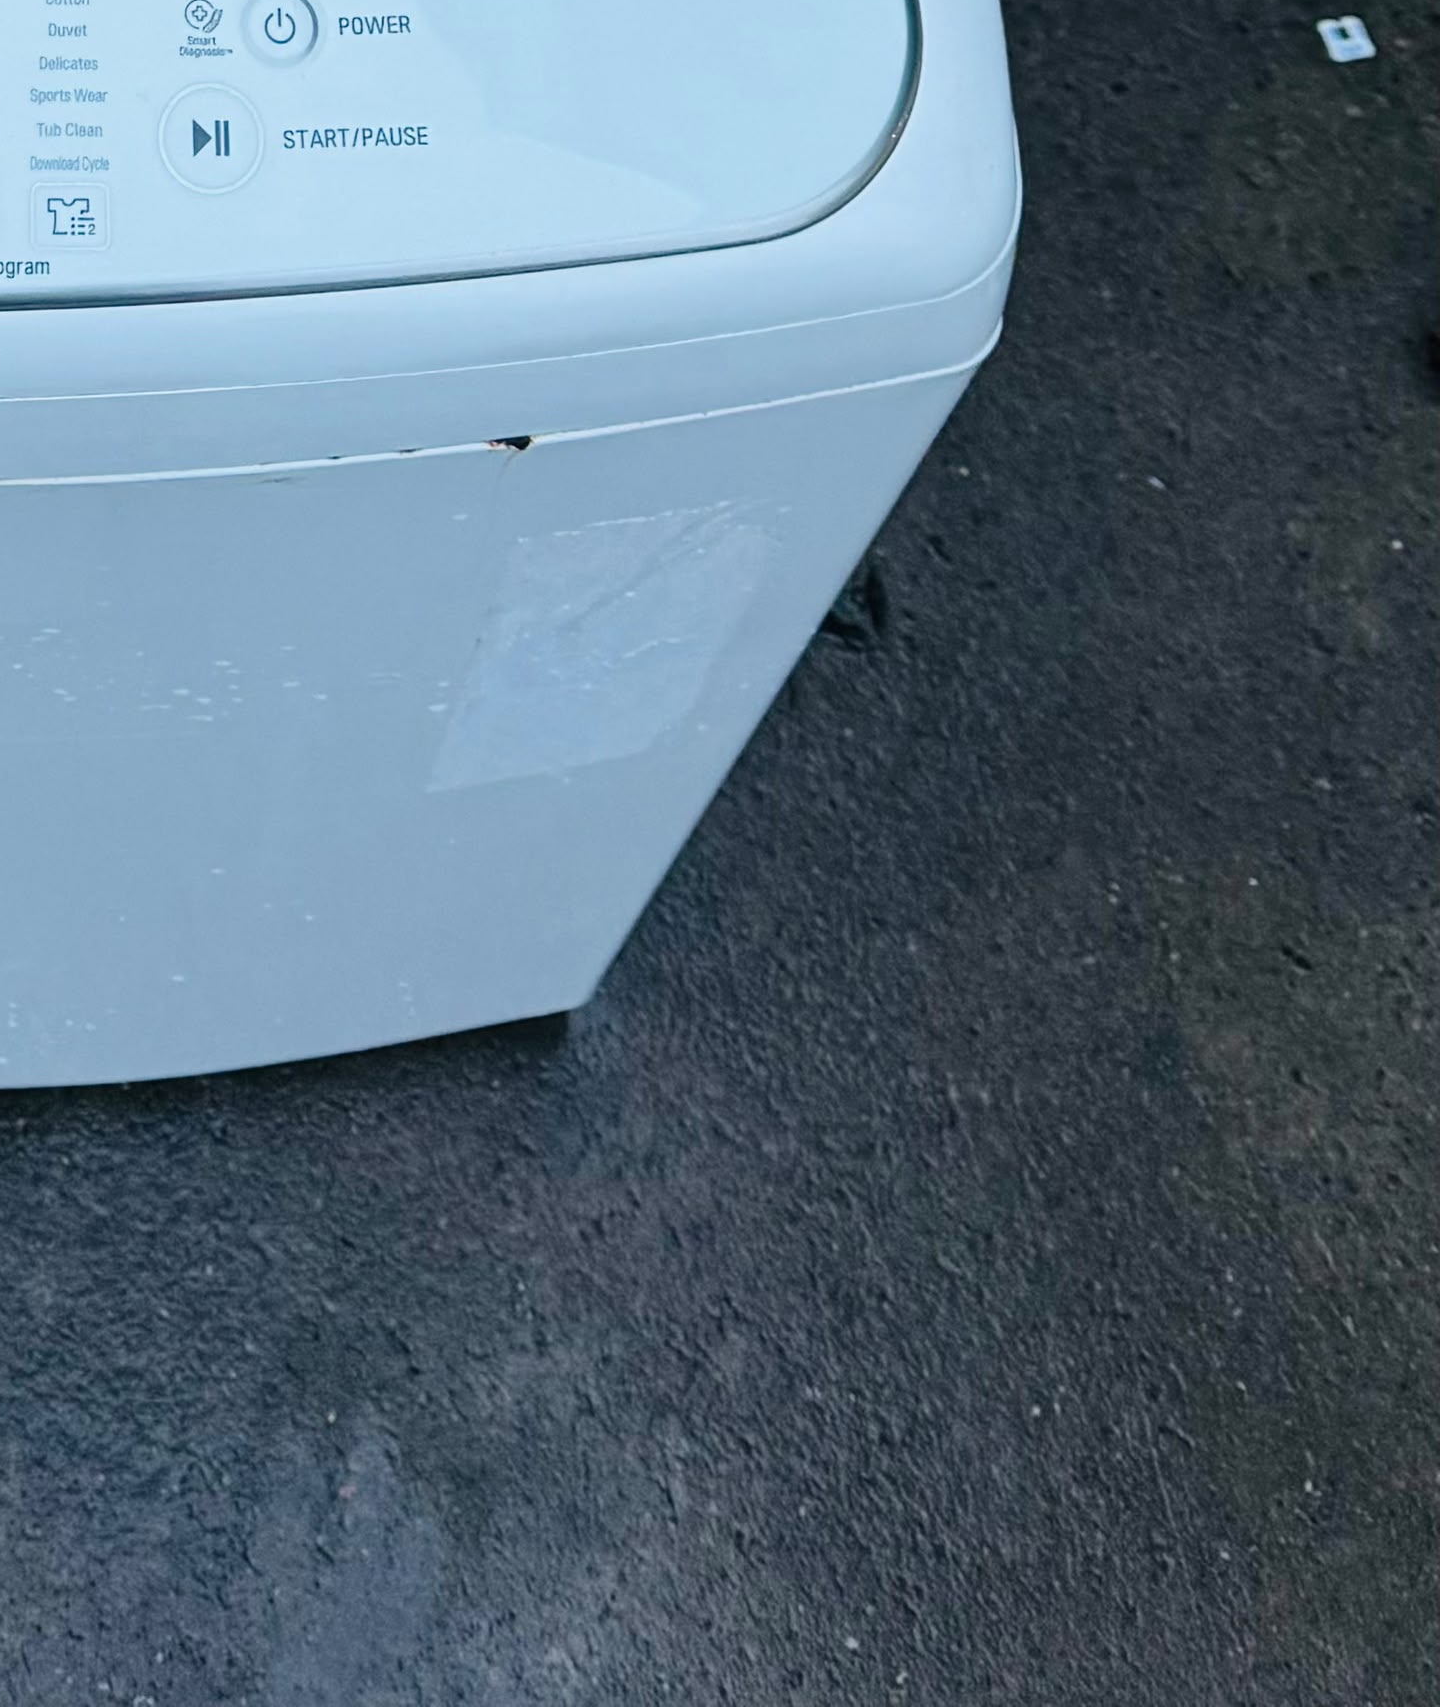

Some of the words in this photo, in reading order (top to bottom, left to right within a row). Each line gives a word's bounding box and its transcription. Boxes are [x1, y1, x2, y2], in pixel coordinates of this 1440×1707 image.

[48, 23, 87, 37] Duvet
[338, 15, 411, 36] POWER
[187, 35, 217, 46] Smart
[39, 56, 98, 71] Delicates
[30, 88, 71, 105] Sports
[73, 88, 108, 103] Wear
[36, 122, 62, 138] Tub
[65, 123, 103, 138] Clean
[283, 126, 429, 149] START/PAUSE
[30, 156, 80, 171] Download
[81, 156, 110, 174] Cycle
